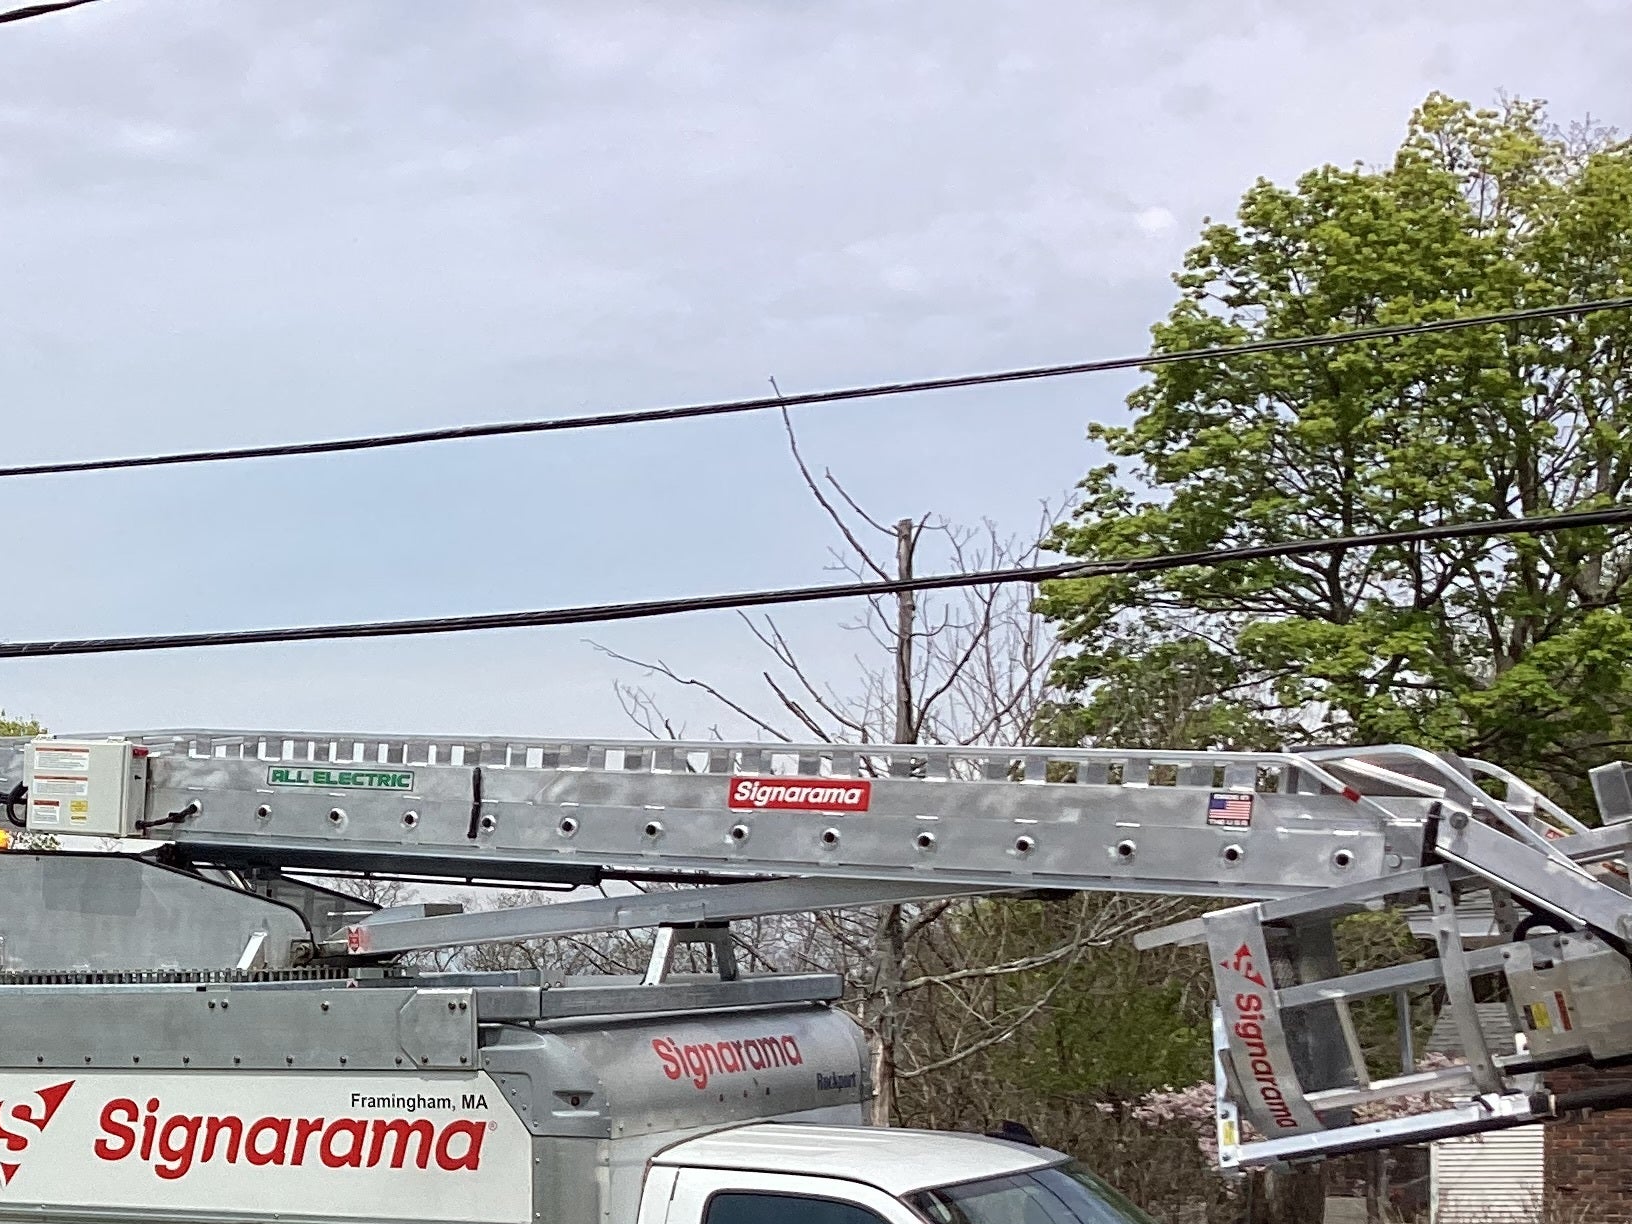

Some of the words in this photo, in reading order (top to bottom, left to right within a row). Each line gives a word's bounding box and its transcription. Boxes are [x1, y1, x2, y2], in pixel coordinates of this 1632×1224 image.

[271, 767, 307, 785] ALL
[311, 768, 409, 789] ELECTRIC
[734, 779, 865, 806] Signarama
[651, 1036, 802, 1090] Signarama
[1234, 992, 1298, 1131] Signarama
[351, 1093, 456, 1113] Framingham,
[461, 1094, 489, 1110] MA
[94, 1098, 487, 1180] Signarama
